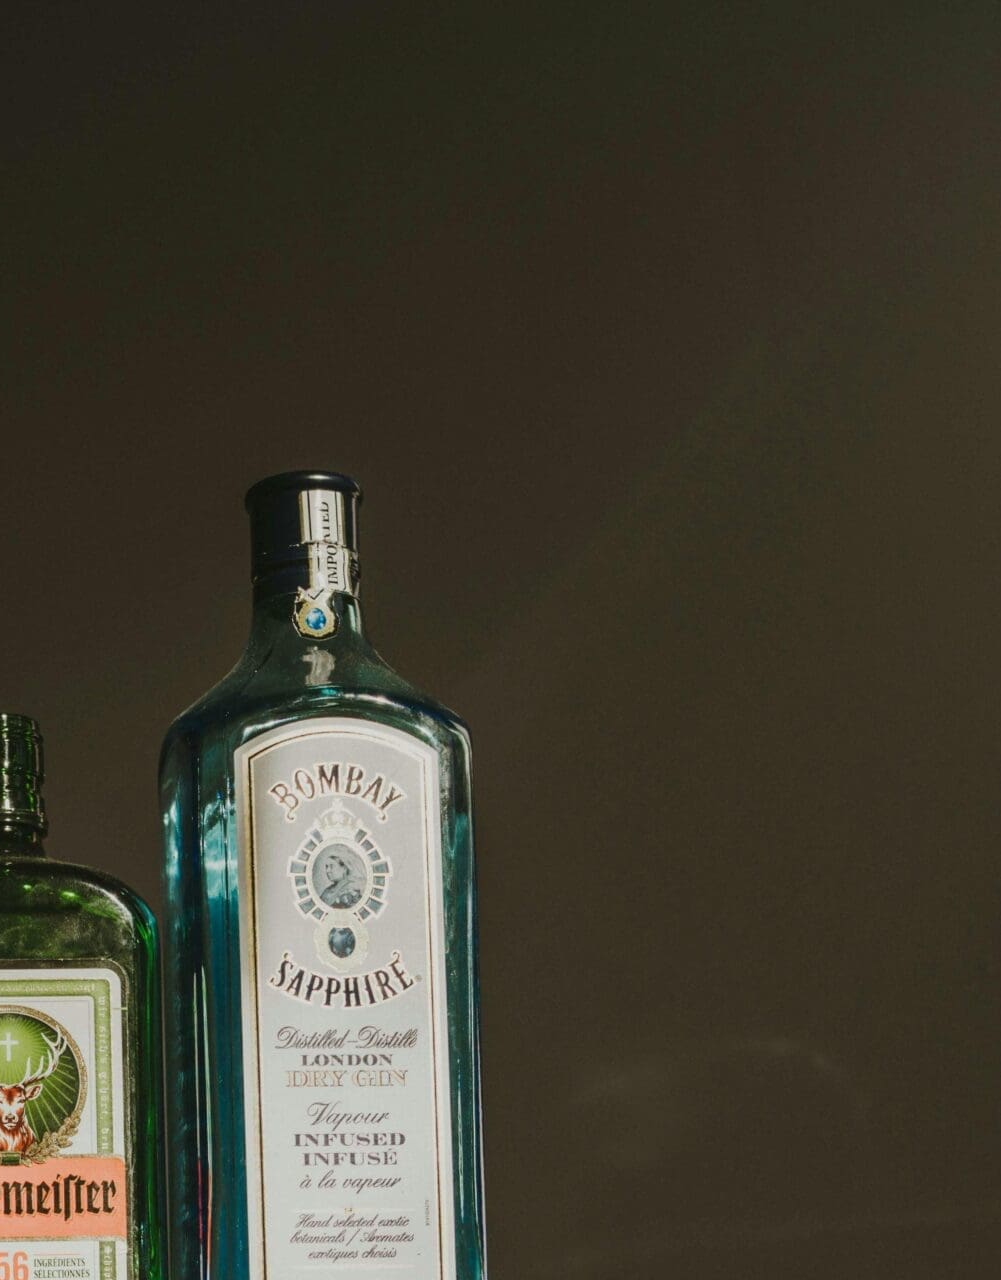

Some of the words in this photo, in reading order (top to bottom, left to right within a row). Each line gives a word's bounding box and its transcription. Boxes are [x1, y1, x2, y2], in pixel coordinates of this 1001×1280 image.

[271, 763, 405, 821] BOMBAY
[270, 951, 415, 1008] SAPPHIRE
[301, 1054, 393, 1066] LONDON
[286, 1070, 347, 1087] DRY
[351, 1069, 408, 1087] GIN
[307, 1101, 390, 1131] Vapour
[294, 1132, 406, 1147] INFUSED
[303, 1148, 397, 1166] INFUSÉ
[299, 1174, 311, 1188] à
[317, 1170, 336, 1188] la
[342, 1175, 401, 1194] vapeur
[295, 1213, 330, 1228] Hand
[333, 1214, 375, 1228] selected
[377, 1216, 410, 1227] exotic
[290, 1228, 345, 1243] botanicals
[359, 1231, 414, 1242] Aromates
[307, 1249, 359, 1263] exotiques
[362, 1246, 397, 1259] choisis
